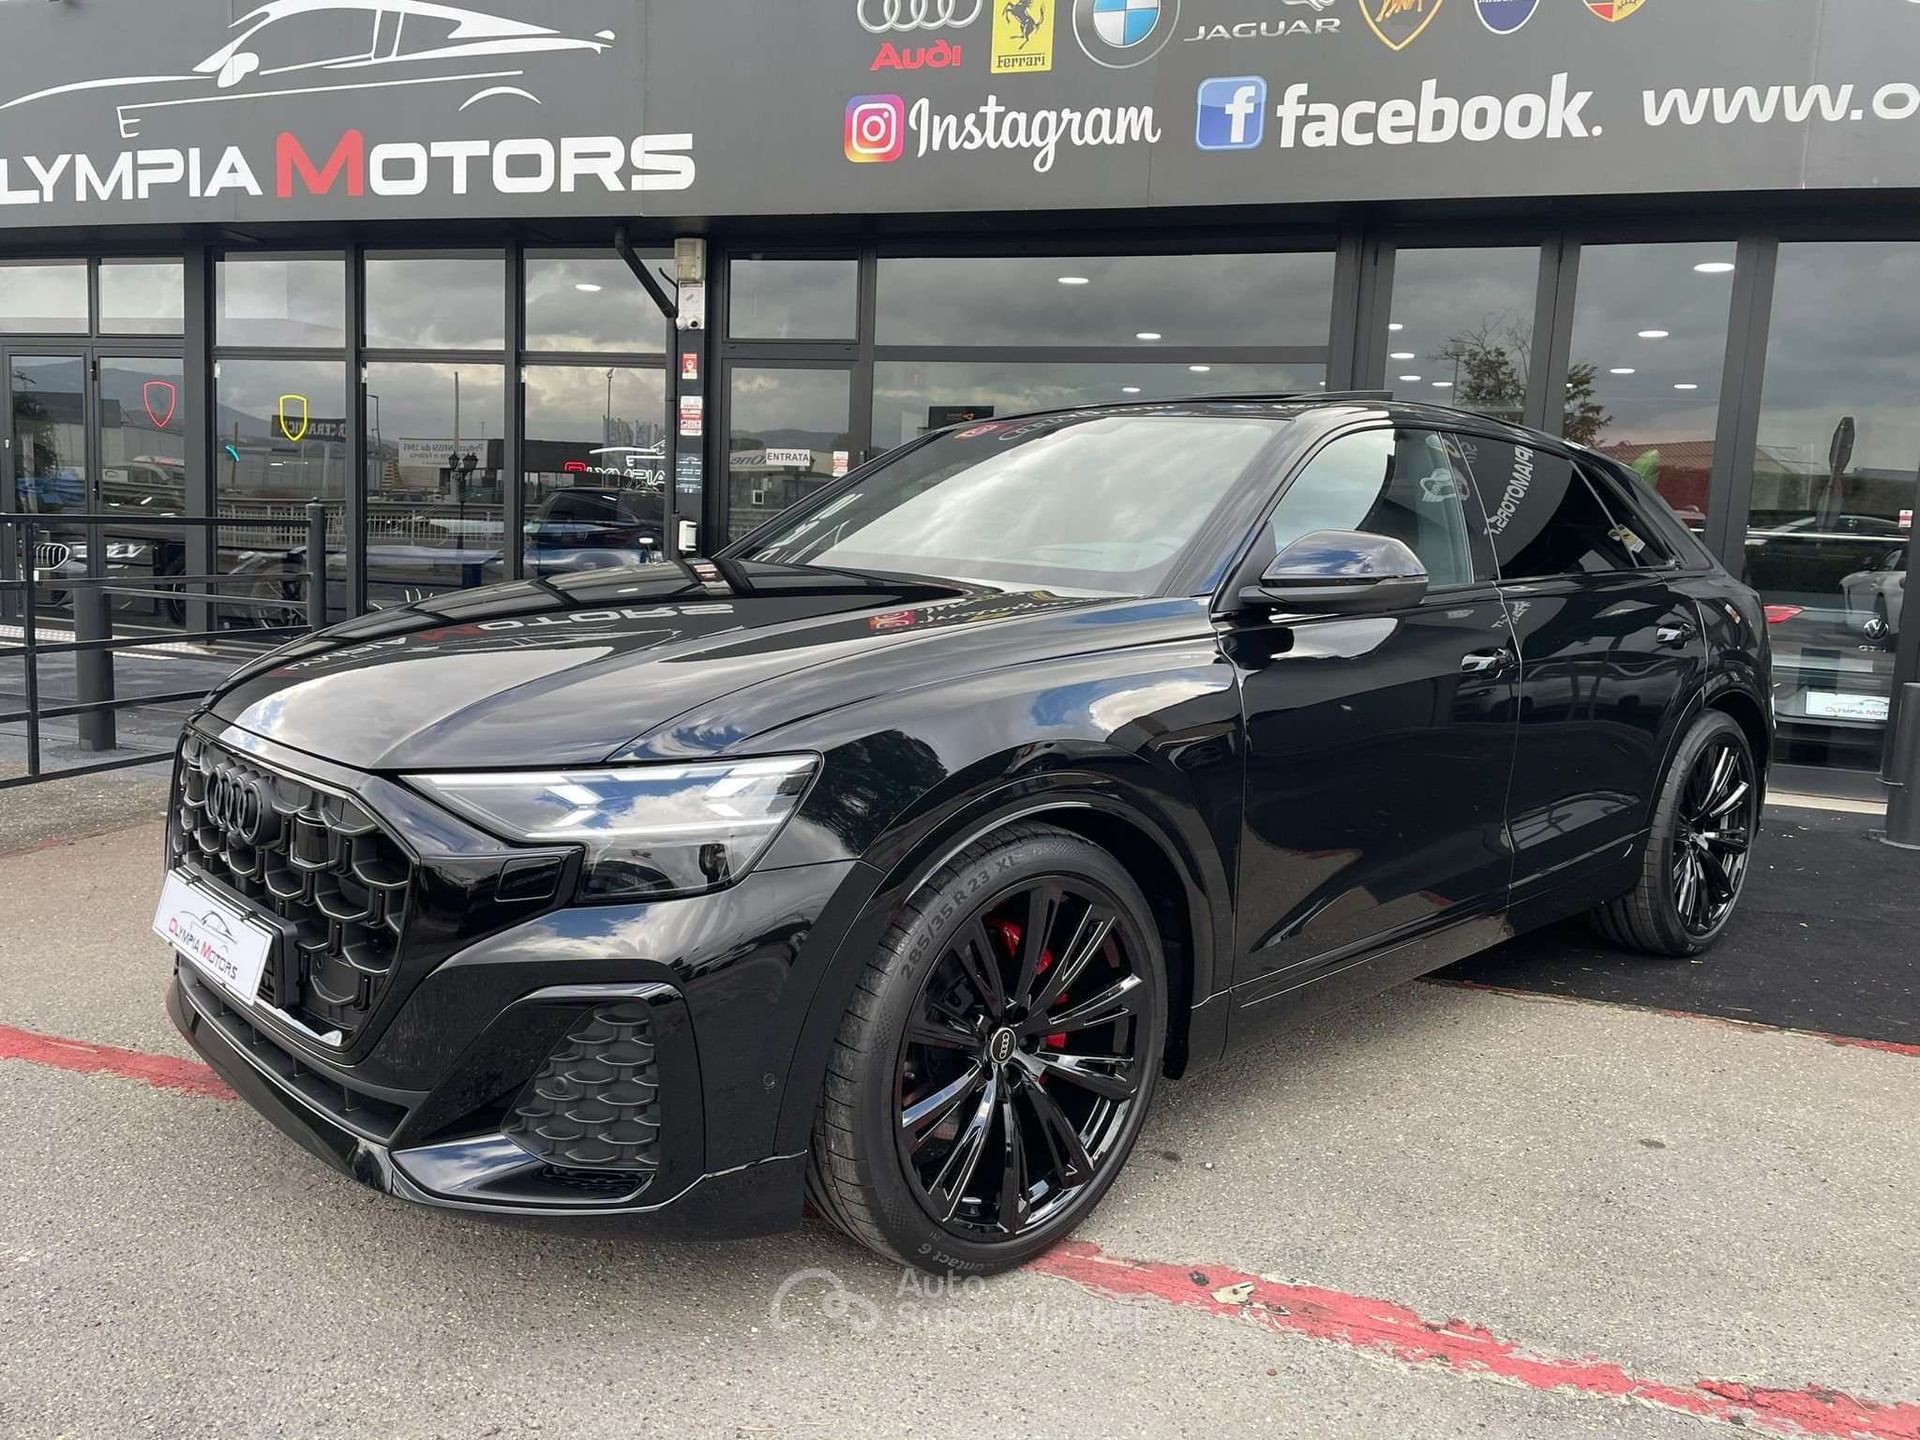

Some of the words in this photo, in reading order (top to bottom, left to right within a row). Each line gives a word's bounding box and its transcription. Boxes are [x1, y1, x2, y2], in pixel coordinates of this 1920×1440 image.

[1183, 18, 1342, 42] JAGUAR
[870, 39, 962, 71] Audi
[996, 54, 1046, 68] Ferrari
[908, 95, 1161, 173] Instagram
[276, 129, 696, 199] MOTORS
[767, 452, 809, 463] ENTRATA
[901, 903, 955, 981] 285/35
[952, 888, 969, 907] R
[967, 870, 991, 893] 23
[199, 940, 239, 981] MOTORS
